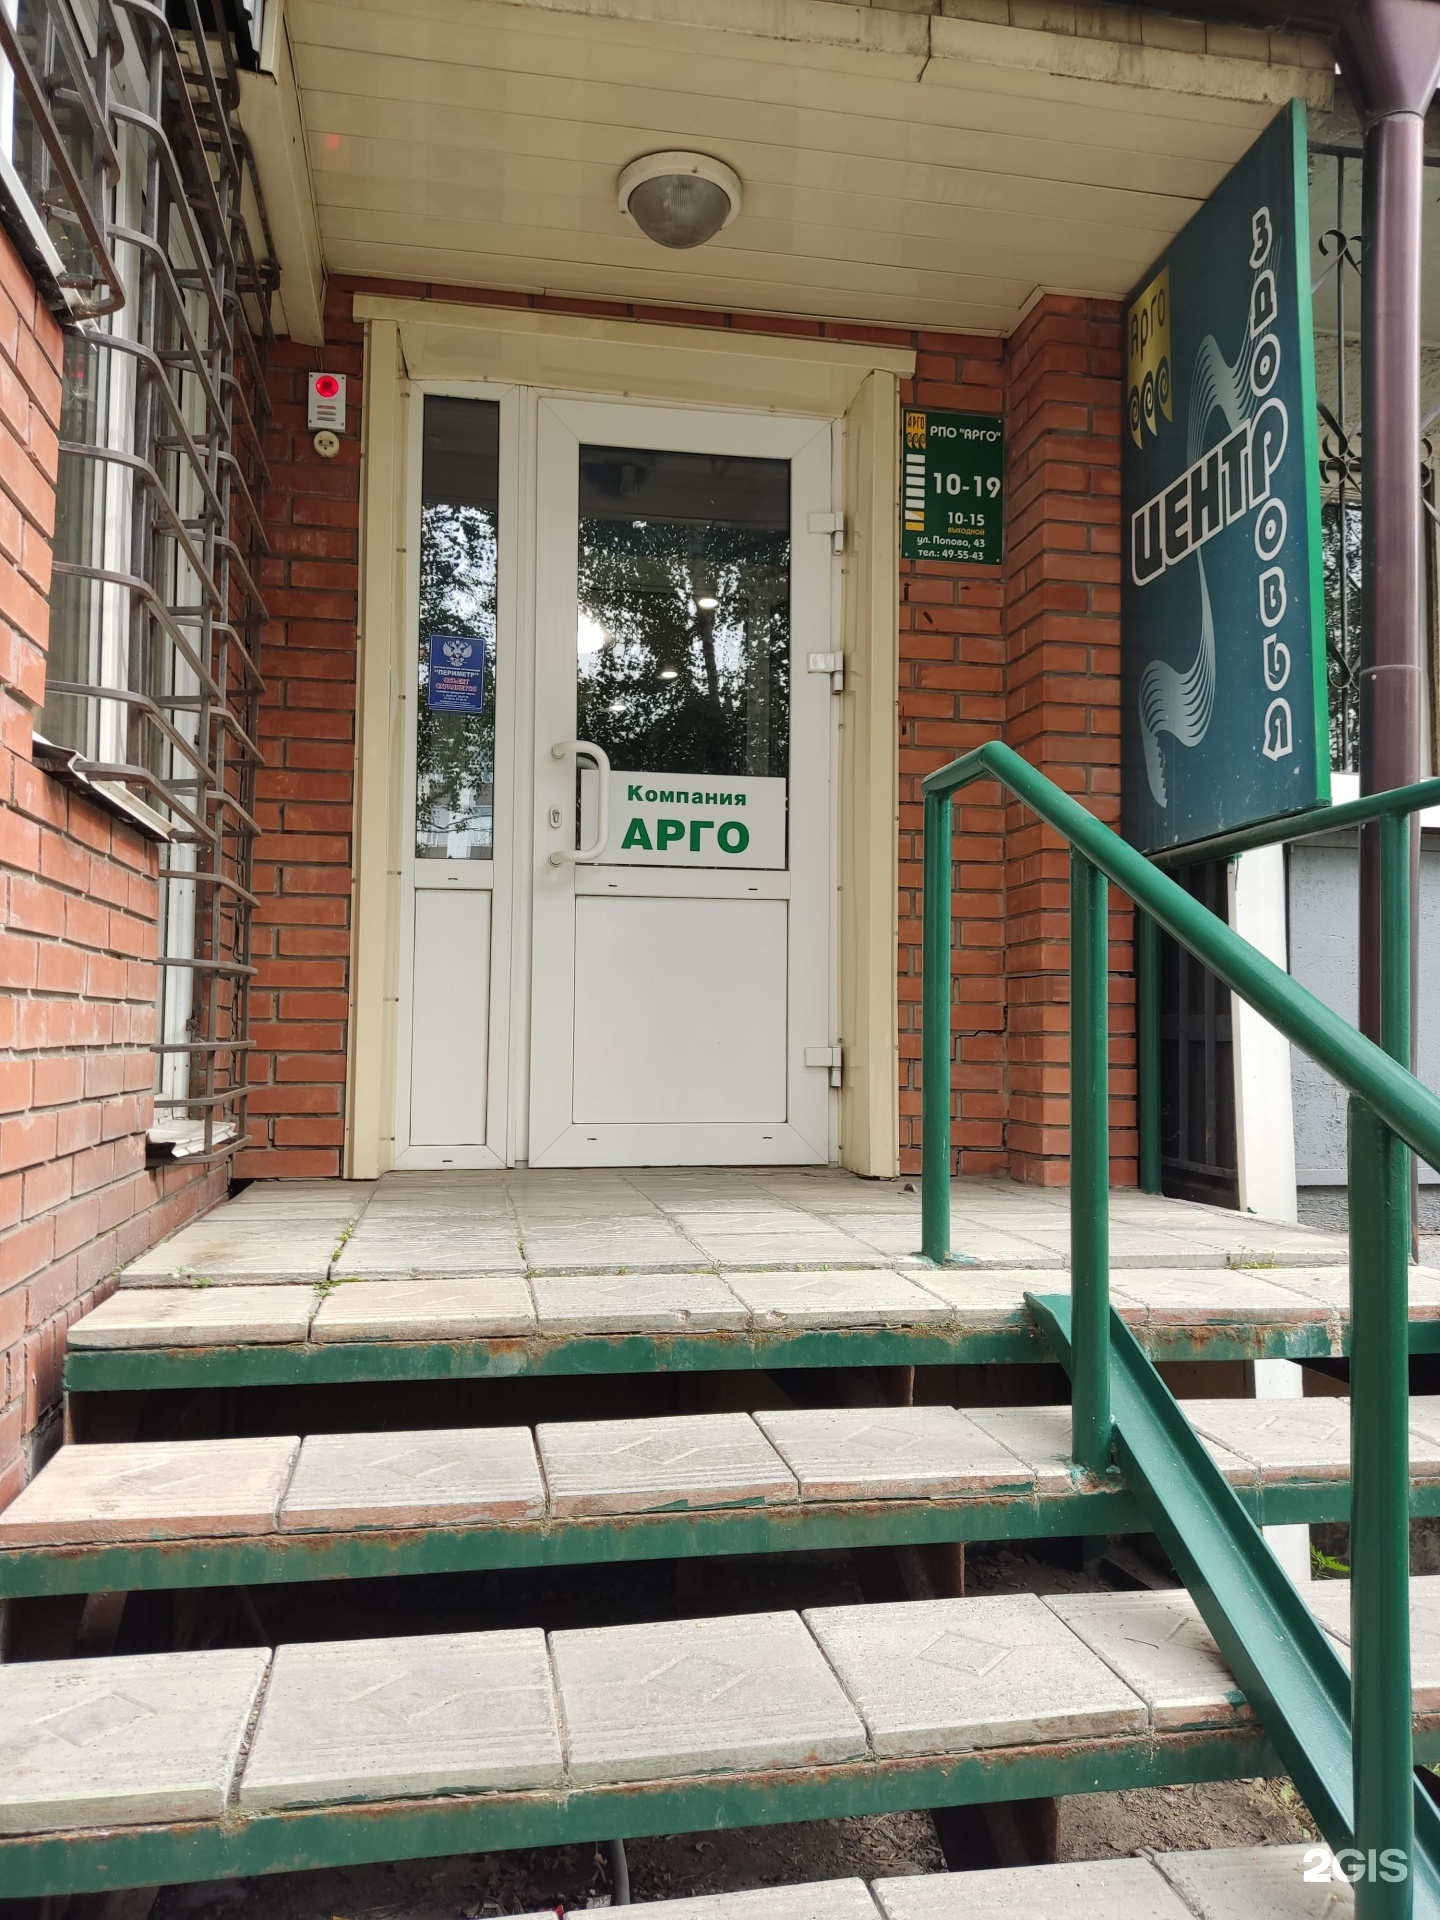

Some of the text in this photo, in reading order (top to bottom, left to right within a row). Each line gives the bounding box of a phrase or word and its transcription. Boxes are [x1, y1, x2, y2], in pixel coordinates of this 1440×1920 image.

[930, 425, 1001, 442] РПО "АРГО"
[933, 472, 1001, 498] 10-19
[1131, 397, 1288, 588] ЦЕНТР
[947, 512, 985, 526] 10-15
[917, 535, 985, 548] ул. Попова, 43
[918, 549, 984, 561] тел.: 49-55-43
[627, 784, 747, 806] Компания
[620, 817, 750, 854] АРГО
